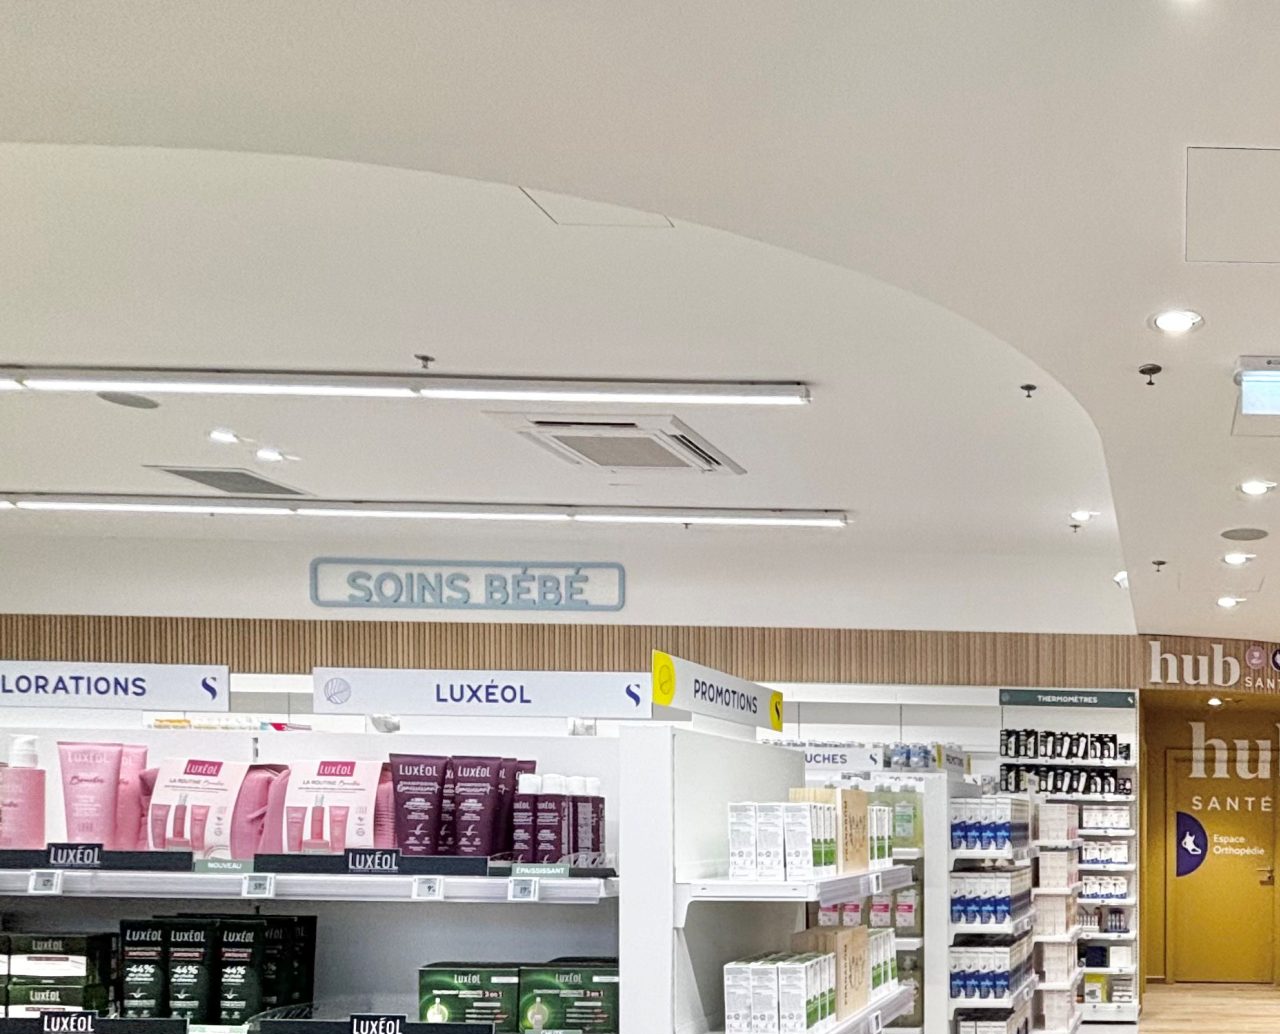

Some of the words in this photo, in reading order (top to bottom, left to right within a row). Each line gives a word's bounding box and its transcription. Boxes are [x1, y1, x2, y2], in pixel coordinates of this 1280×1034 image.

[347, 570, 470, 605] SOINS
[485, 567, 590, 605] BÉBÉ
[1149, 640, 1240, 686] hub
[1, 675, 147, 696] LORATIONS
[436, 676, 531, 704] LUXÉOL
[694, 679, 758, 714] PROMOTIONS
[805, 754, 848, 764] UCHES
[186, 763, 219, 775] LUXÉOL
[319, 764, 352, 776] LUXÉOL
[399, 764, 438, 777] LUXÉOL
[457, 765, 491, 778] LUXÉOL
[1192, 795, 1272, 811] SANTÉ
[1213, 834, 1245, 846] Espace
[50, 847, 101, 864] LUXÉOL
[1213, 846, 1264, 857] Orthopédie
[349, 852, 398, 869] LUXÉOL
[126, 928, 162, 942] LUXÉOL
[170, 929, 206, 942] LUXÉOL
[223, 930, 254, 943] LUXÉOL
[454, 973, 480, 984] LUXÉOL
[29, 989, 61, 1002] LUXÉOL
[43, 1014, 95, 1032] LUXÉOL
